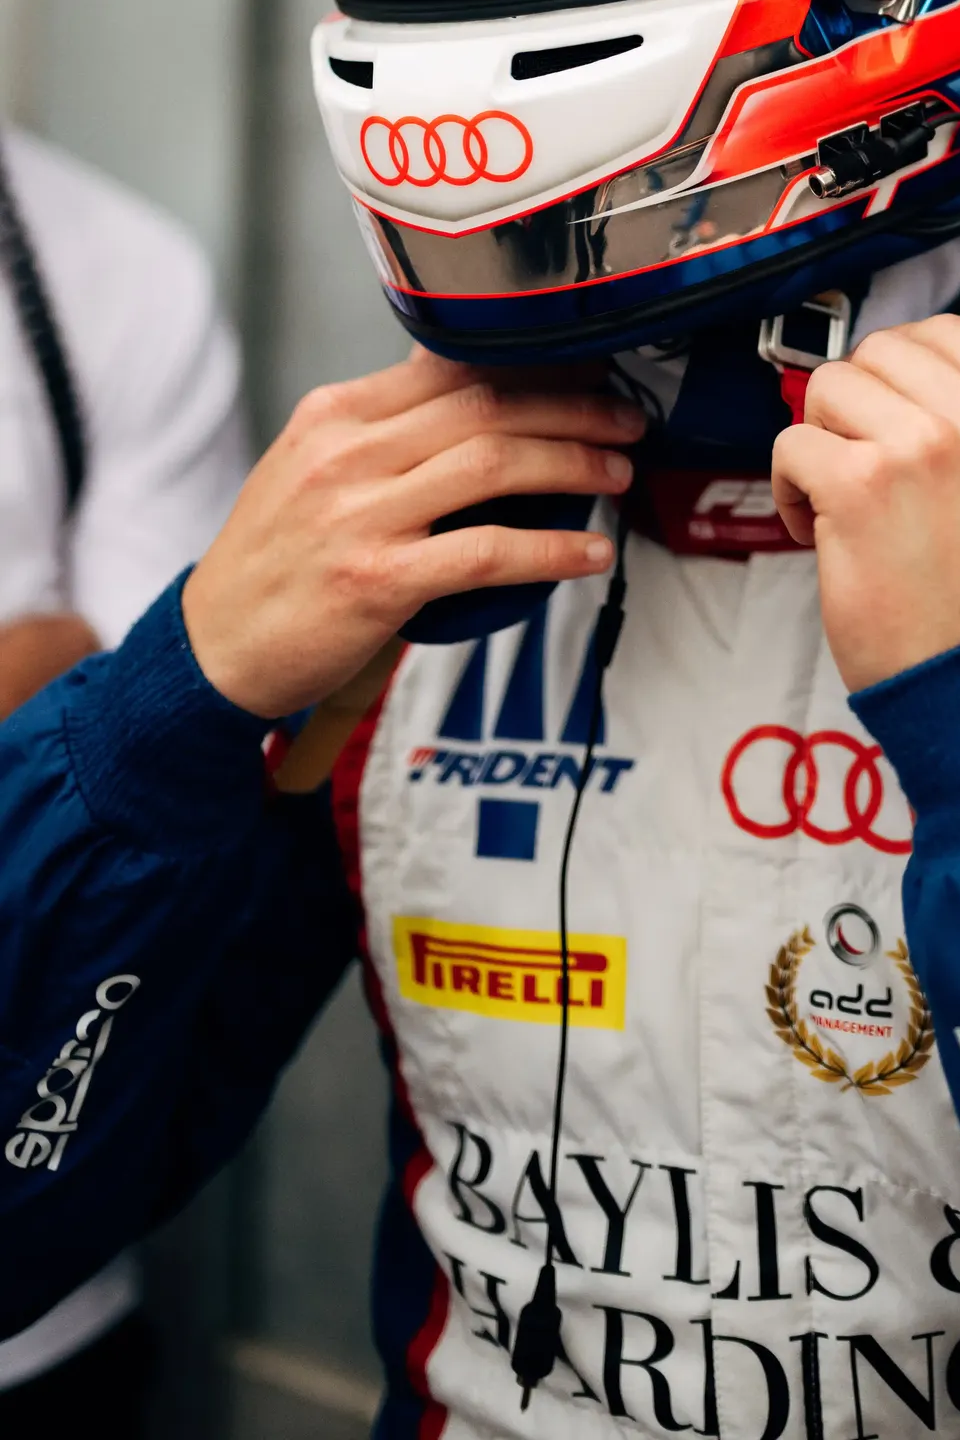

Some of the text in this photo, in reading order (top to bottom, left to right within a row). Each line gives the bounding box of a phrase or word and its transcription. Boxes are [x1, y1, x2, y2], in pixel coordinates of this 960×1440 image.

[408, 931, 609, 1009] PIRELLI
[5, 974, 141, 1171] sparco
[447, 1120, 881, 1302] BAYLIS
